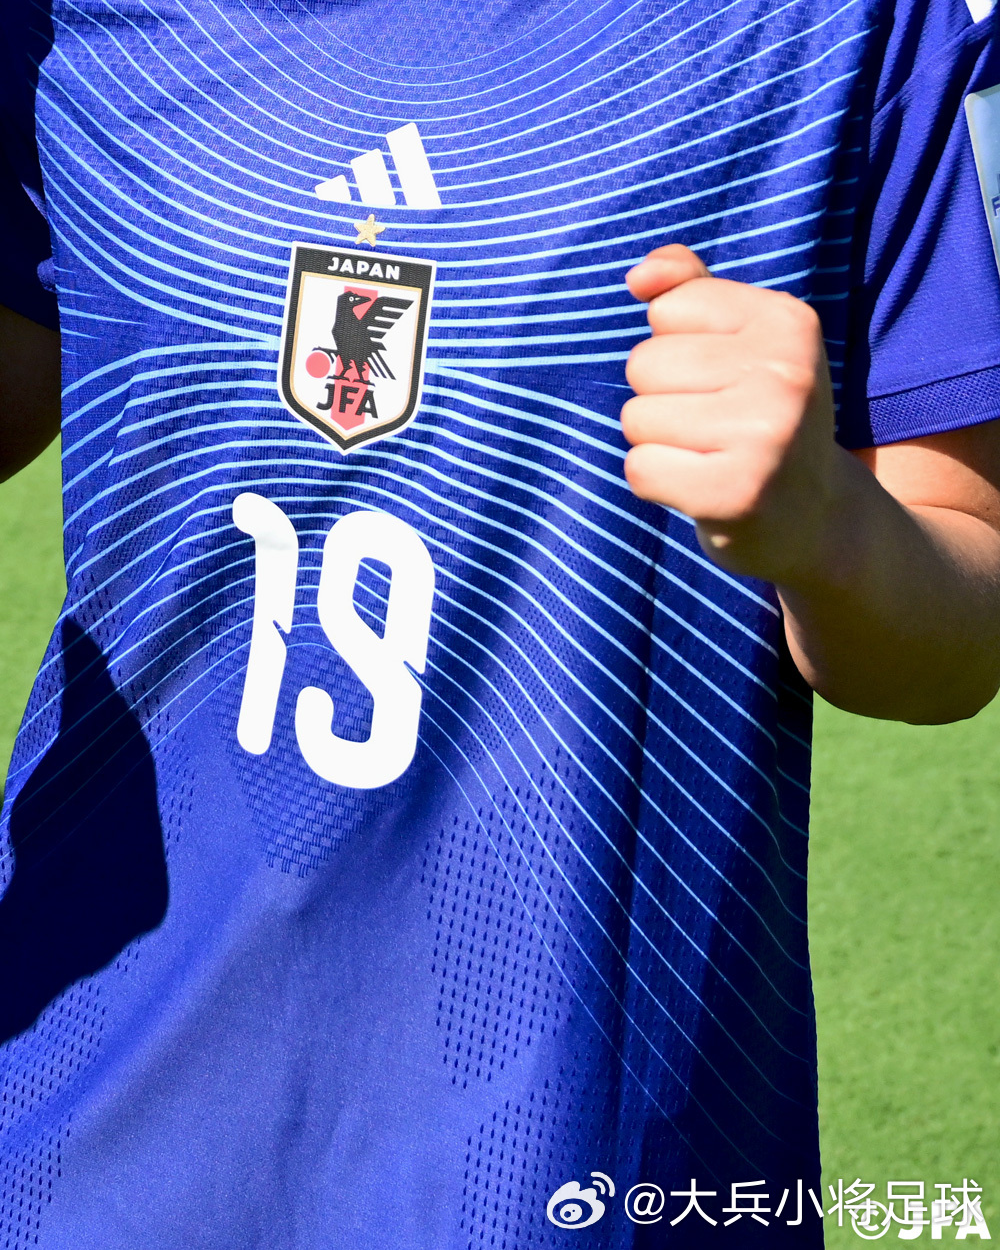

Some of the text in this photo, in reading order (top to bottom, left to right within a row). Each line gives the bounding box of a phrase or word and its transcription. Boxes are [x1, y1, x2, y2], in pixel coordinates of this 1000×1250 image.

[328, 257, 400, 280] JAPAN
[316, 383, 379, 420] JFA
[232, 492, 436, 789] 19
